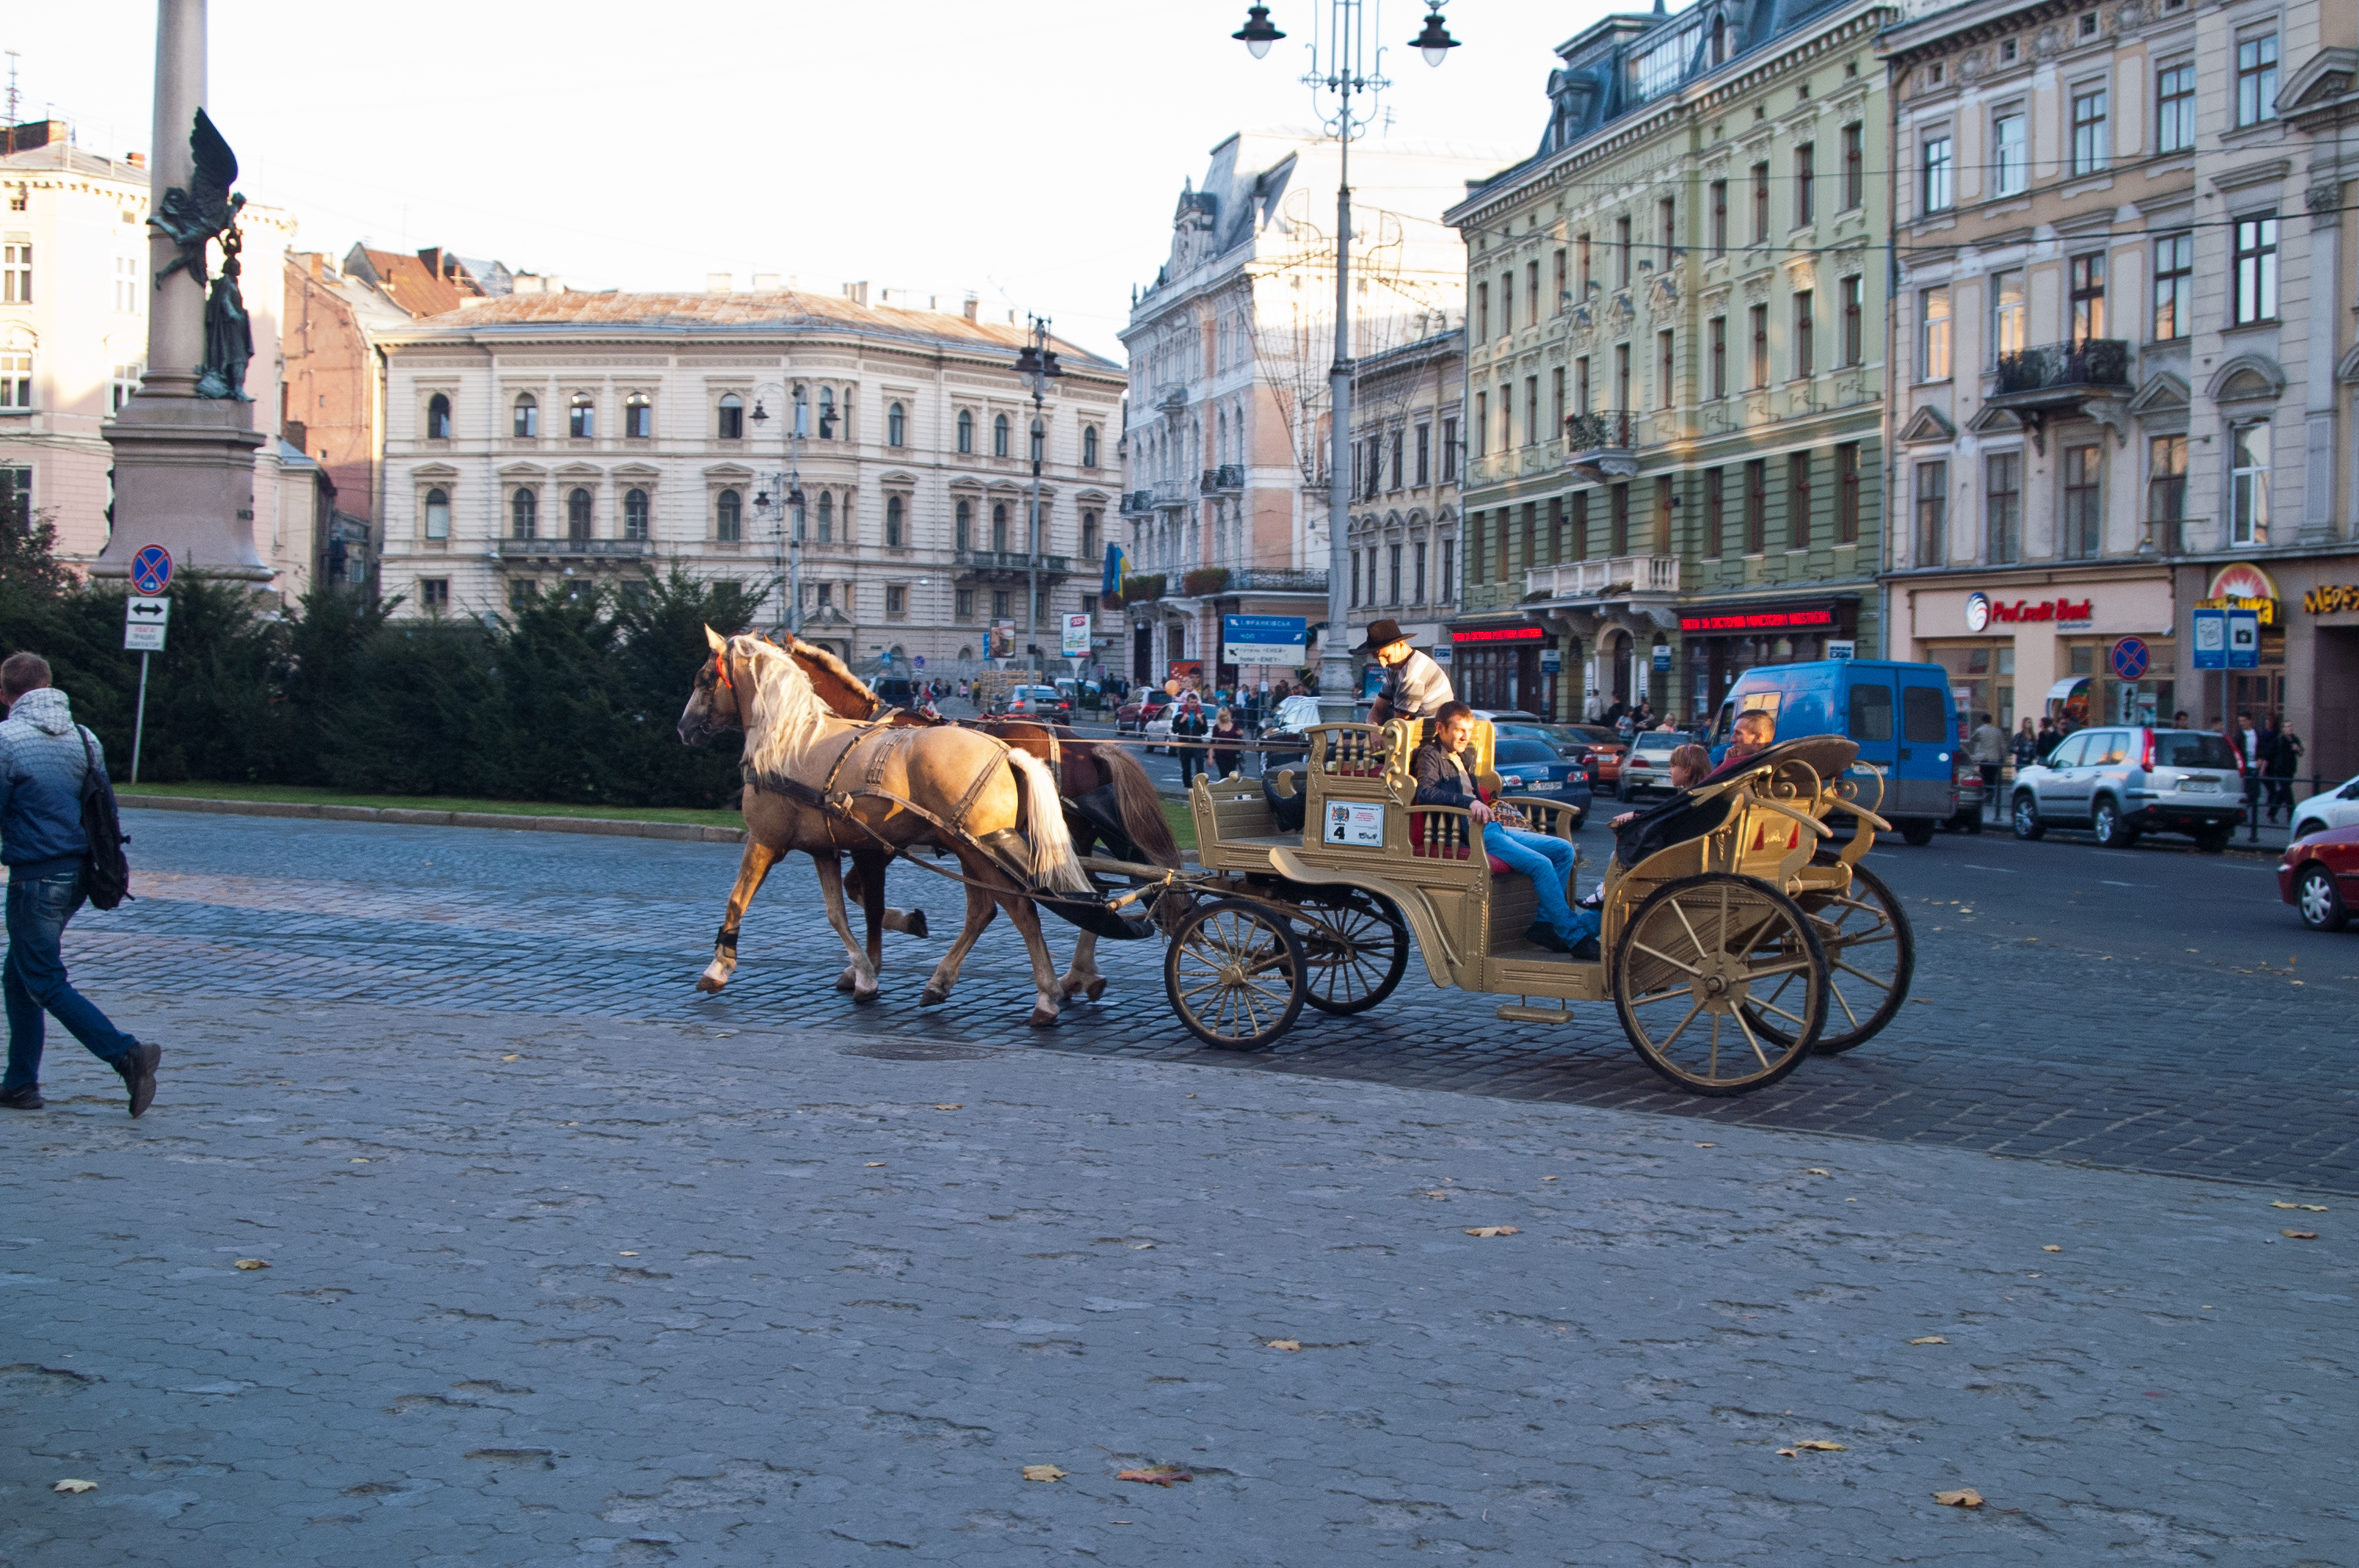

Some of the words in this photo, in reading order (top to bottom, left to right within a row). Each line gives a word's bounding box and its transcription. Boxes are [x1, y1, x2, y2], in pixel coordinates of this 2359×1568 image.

[1992, 601, 2053, 622] ProCredit
[2055, 597, 2092, 620] Bank
[1333, 826, 1346, 840] 4
